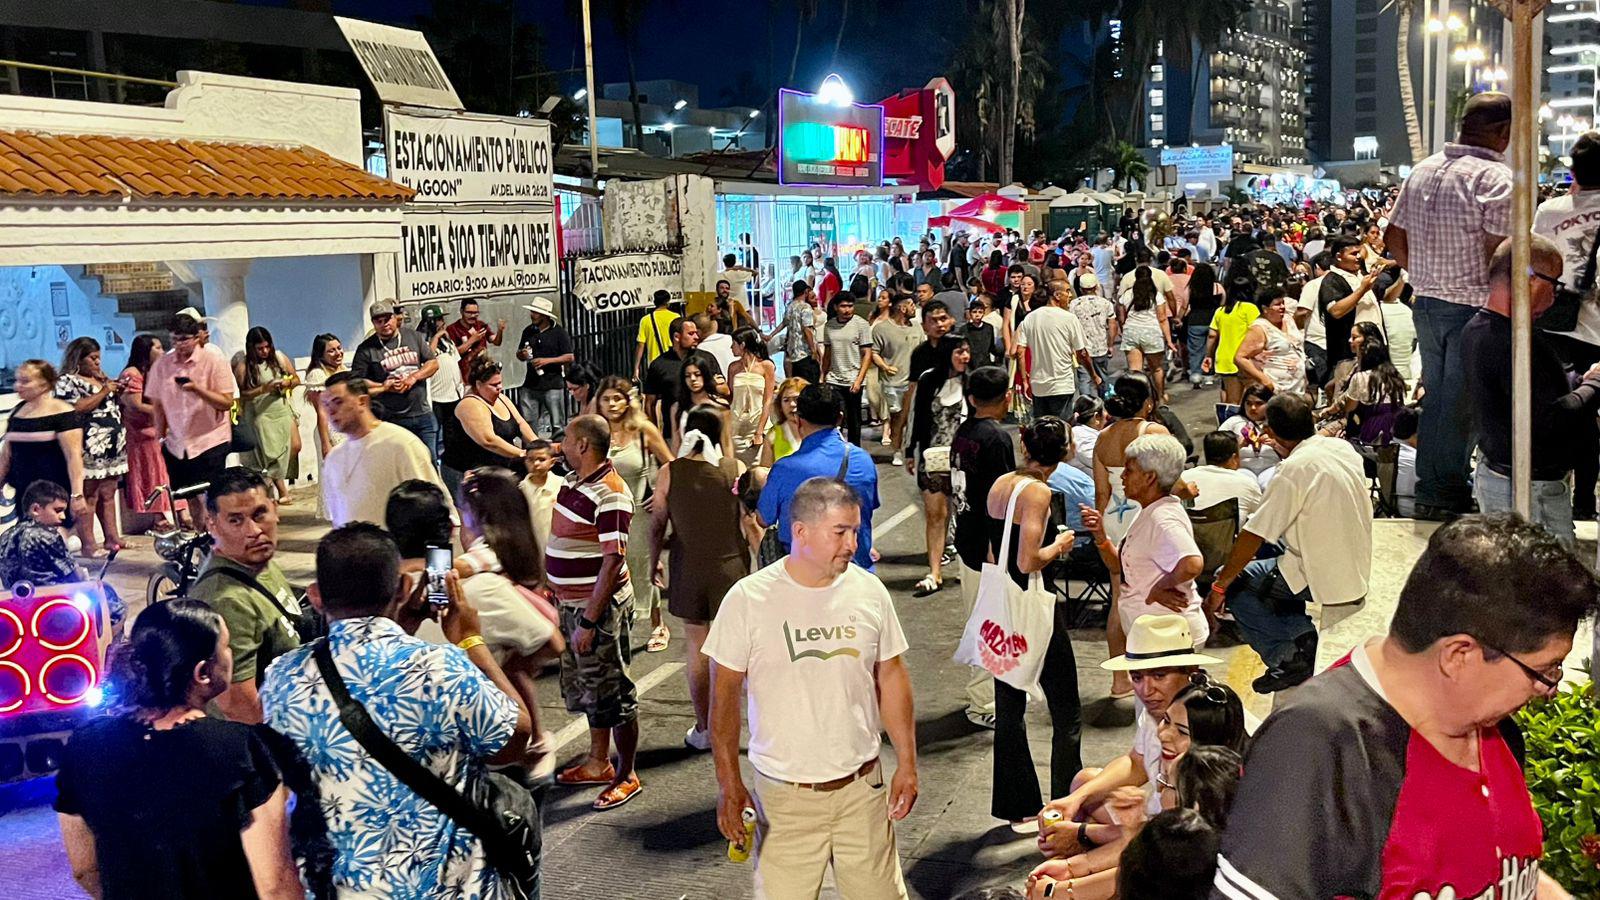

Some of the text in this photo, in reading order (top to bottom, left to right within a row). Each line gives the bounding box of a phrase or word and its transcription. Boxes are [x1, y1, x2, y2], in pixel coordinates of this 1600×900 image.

[394, 128, 548, 174] ESTACIONAMIENTO PÚBLICO
[515, 184, 530, 196] MAR
[401, 220, 550, 273] TARIFA $100 TIEMPO LIBRE
[412, 279, 464, 296] HORARIO:
[465, 275, 488, 292] 9:00
[490, 276, 505, 288] AM
[508, 275, 515, 287] A
[538, 273, 550, 286] PM
